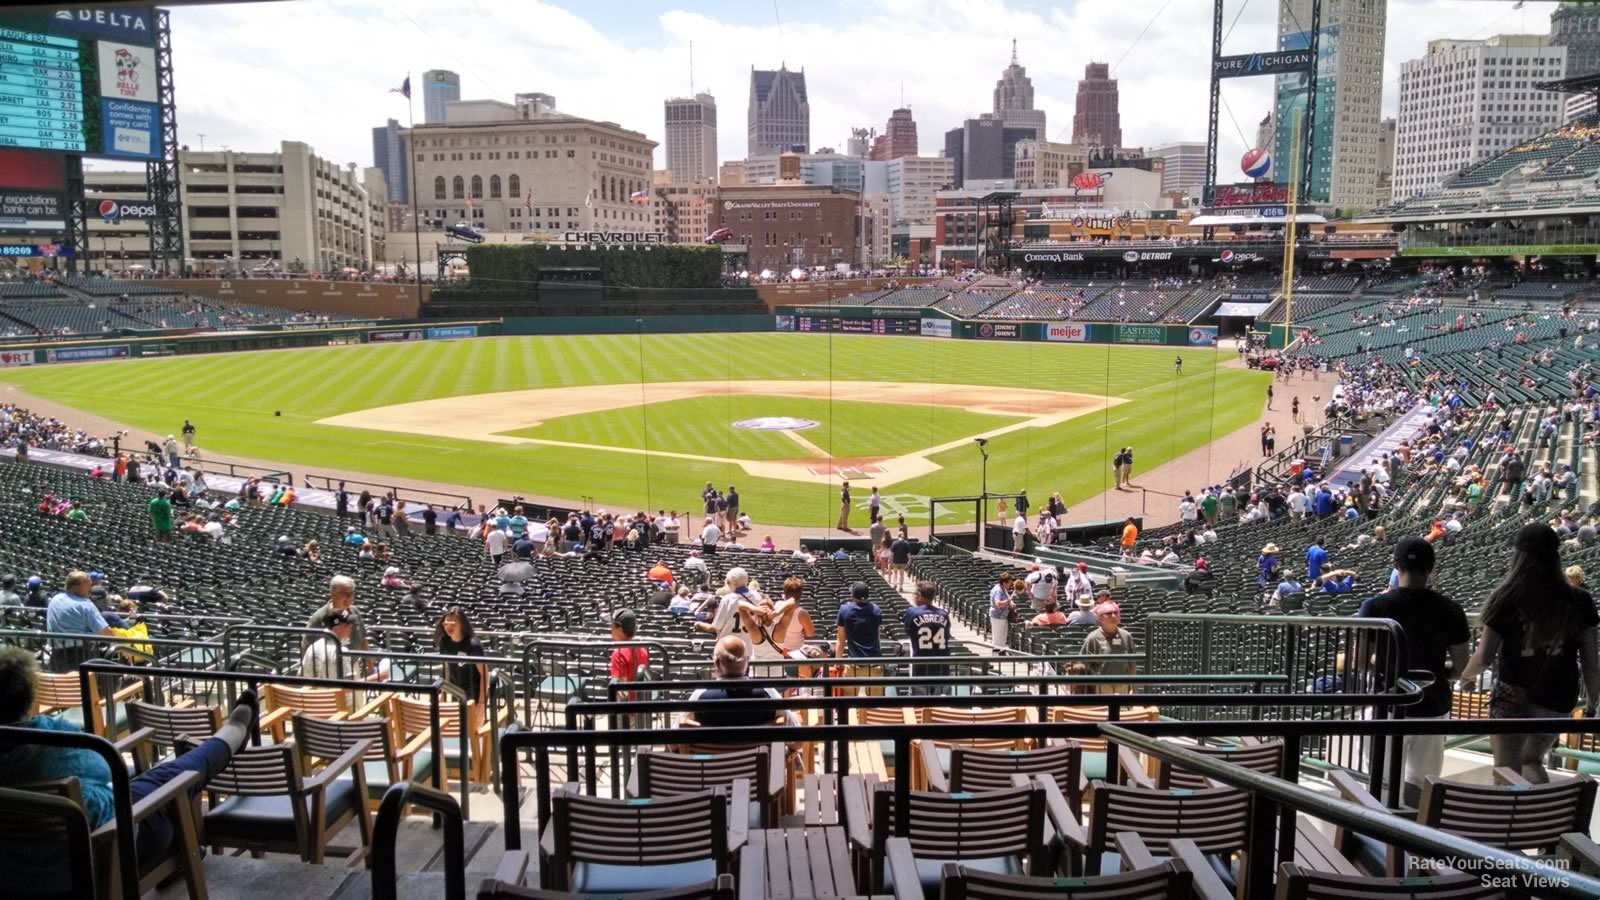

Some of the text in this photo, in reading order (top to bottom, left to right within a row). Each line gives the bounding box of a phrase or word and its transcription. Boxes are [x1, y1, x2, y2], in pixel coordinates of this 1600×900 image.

[79, 9, 145, 31] DELTA
[31, 34, 48, 44] ERA
[32, 48, 47, 56] SEA
[57, 50, 73, 60] 2.11
[57, 61, 73, 70] 2.51
[1216, 52, 1309, 72] PURE MICHIGAN
[33, 68, 74, 79] OAK 2.53
[34, 78, 48, 86] TOR
[59, 81, 75, 90] 2.60
[116, 82, 139, 91] BELLE
[36, 89, 75, 100] TEX 2.63
[120, 89, 136, 97] TIRE
[61, 101, 76, 110] 2.71
[109, 102, 152, 114] Confidence
[36, 109, 77, 120] BOS 2.73
[109, 111, 153, 123] comes with
[62, 121, 78, 130] 2.86
[109, 119, 131, 128] every
[38, 130, 79, 140] OAK 2.97
[40, 140, 53, 148] DET
[64, 142, 80, 150] 3.18
[1075, 173, 1101, 189] AAA
[5, 194, 57, 205] expectations
[3, 204, 59, 215] bank can be.
[120, 205, 157, 217] pepsi
[1226, 208, 1260, 216] AMSTERDAM
[1263, 208, 1276, 216] 416
[565, 232, 665, 243] CHEVROLET
[3, 246, 32, 255] 89269
[1141, 252, 1172, 260] DETROIT
[1063, 253, 1084, 261] Bank
[1234, 253, 1257, 262] pepsi
[1050, 326, 1082, 338] meijer
[1120, 325, 1160, 335] EASTERN
[918, 627, 946, 649] 24
